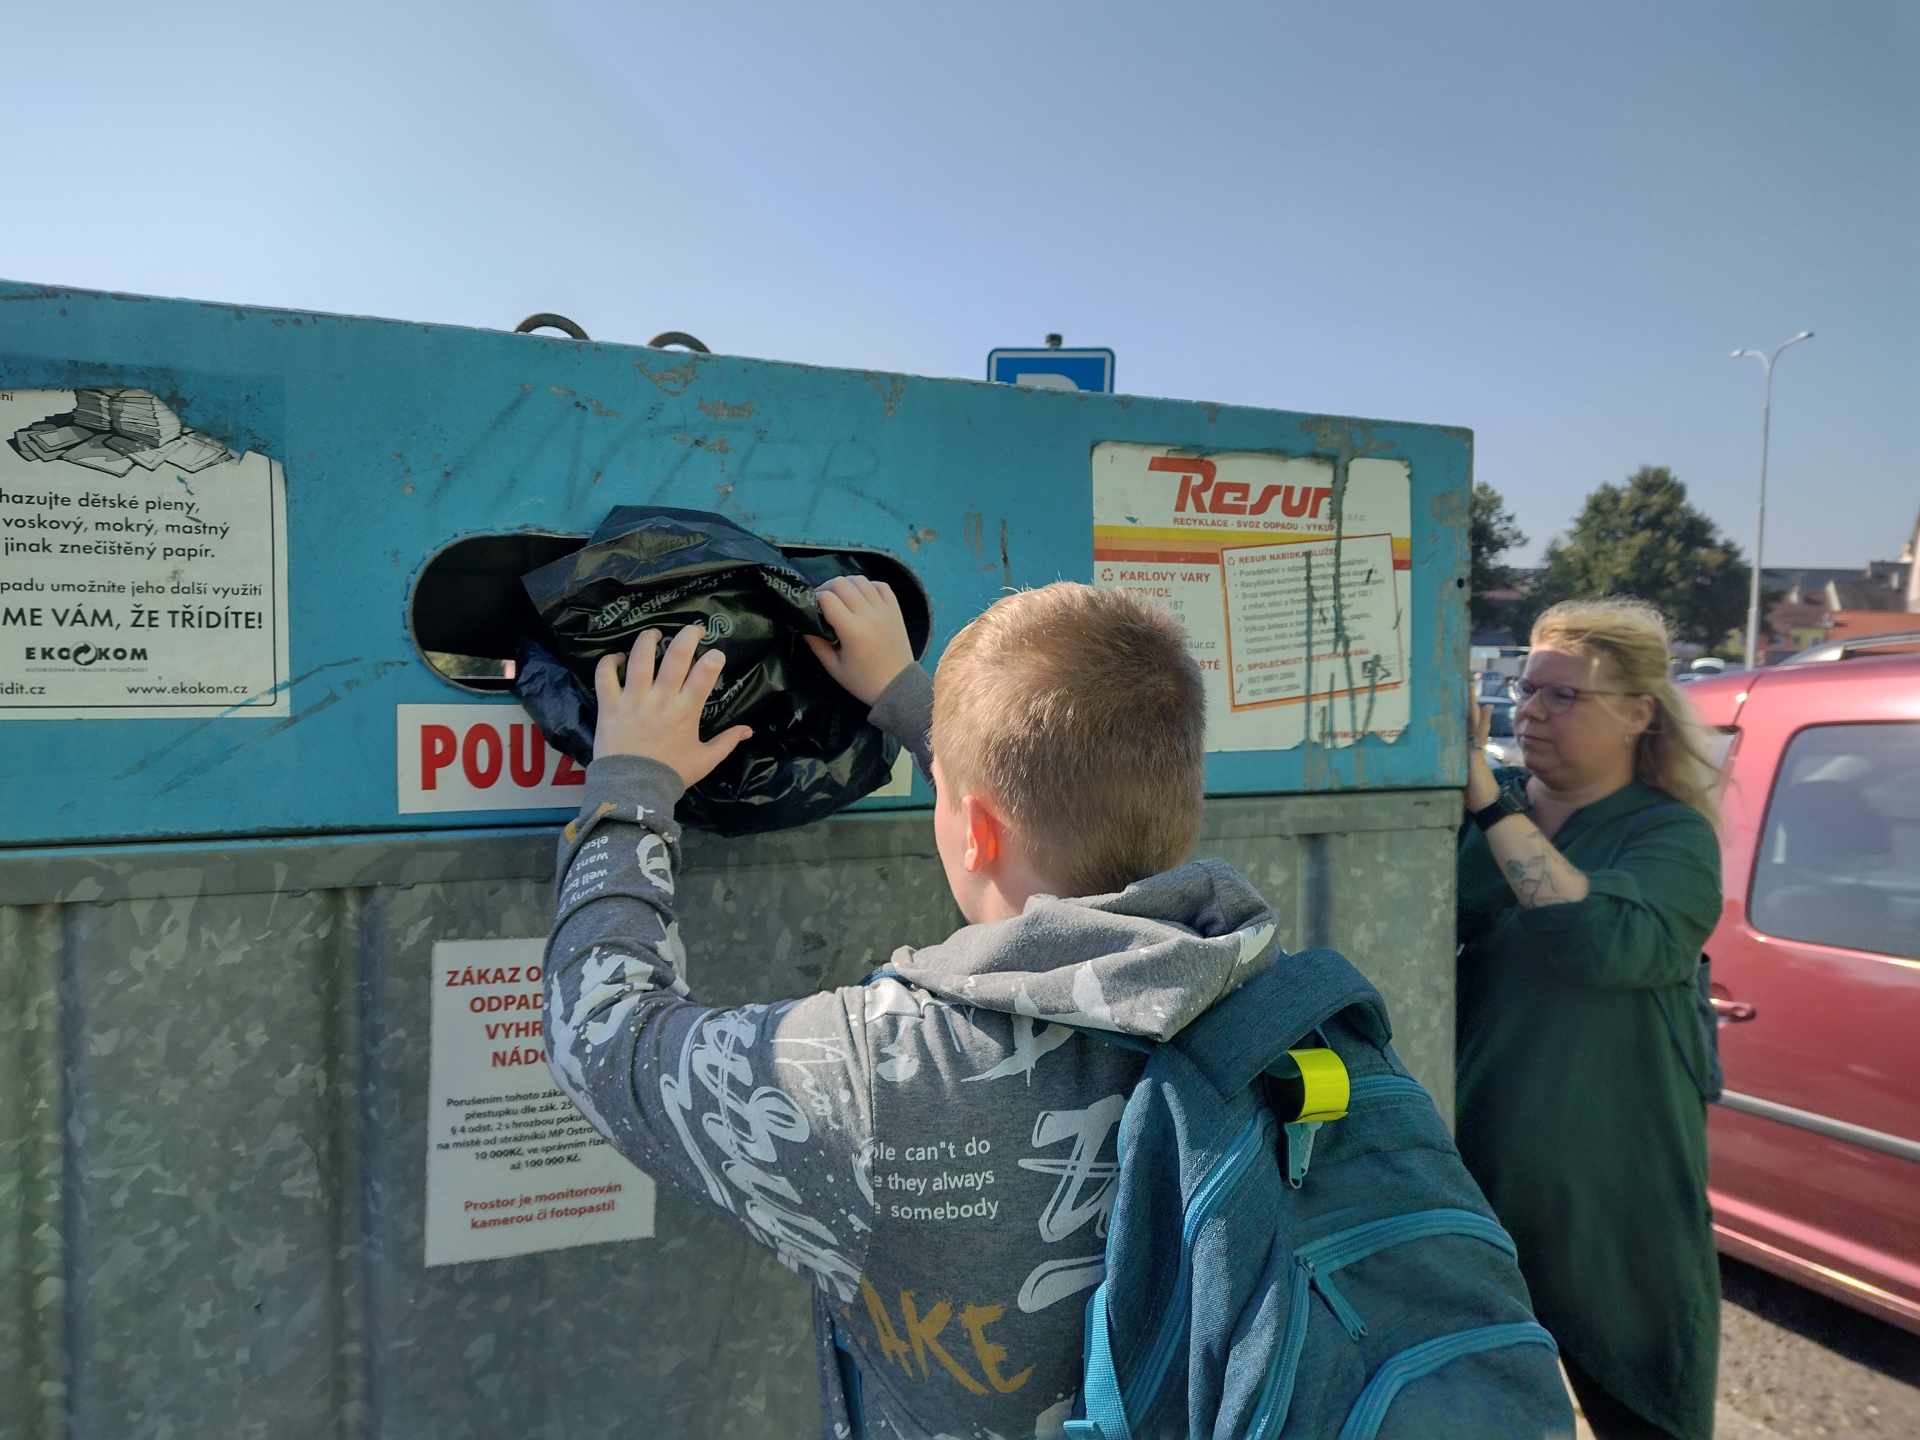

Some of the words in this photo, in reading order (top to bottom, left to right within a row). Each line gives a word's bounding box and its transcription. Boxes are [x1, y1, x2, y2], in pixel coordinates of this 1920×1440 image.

[78, 491, 140, 509] dětské
[2, 513, 89, 535] voskový,
[95, 517, 158, 536] mokrý,
[165, 521, 231, 540] mastný
[4, 537, 53, 556] jinak
[59, 540, 157, 560] znečištěný
[162, 543, 215, 561] papír.
[1120, 570, 1177, 581] KARLOVY
[1180, 572, 1211, 582] VARY
[131, 580, 166, 597] jeho
[170, 580, 208, 596] další
[212, 583, 263, 600] využití
[51, 602, 122, 632] VÁM,
[130, 603, 160, 629] ŽE
[168, 604, 264, 630] TŘÍDÍTE!
[126, 681, 249, 696] www.ekokom.cz
[446, 965, 522, 987] ZÁKAZ
[446, 1095, 503, 1107] Porušením
[505, 1091, 541, 1102] tohoto
[464, 1107, 519, 1122] přestupku
[520, 1103, 537, 1114] dle
[512, 1115, 555, 1130] hrozbou
[436, 1142, 450, 1151] na
[452, 1138, 481, 1150] místě
[483, 1136, 497, 1147] od
[527, 1146, 540, 1155] ve
[541, 1140, 587, 1156] správním
[964, 1136, 991, 1157] do
[524, 1158, 545, 1169] 100
[545, 1155, 566, 1166] 000
[887, 1172, 928, 1196] they
[932, 1169, 995, 1192] always
[463, 1197, 516, 1212] Prostor
[517, 1194, 532, 1208] je
[534, 1183, 624, 1203] monitorován
[890, 1197, 999, 1220] somebody
[470, 1212, 534, 1231] kamerou
[536, 1207, 548, 1222] či
